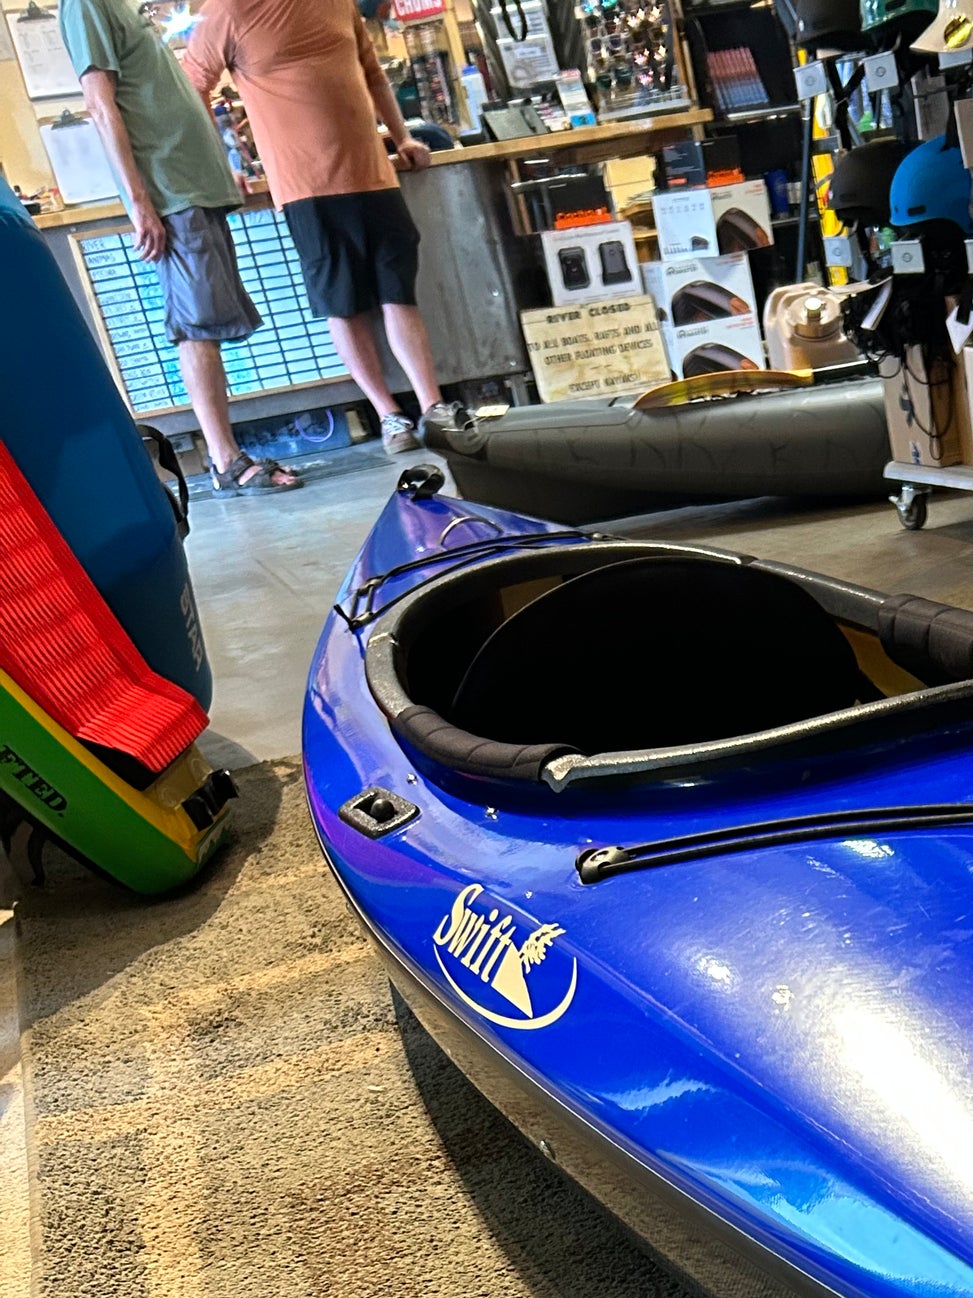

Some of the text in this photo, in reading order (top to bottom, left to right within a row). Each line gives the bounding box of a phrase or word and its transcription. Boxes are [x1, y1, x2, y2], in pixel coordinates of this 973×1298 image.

[546, 303, 631, 325] RIVER CLOSED
[623, 325, 641, 335] AND
[544, 354, 573, 365] OTHER
[619, 339, 654, 353] DEVICES
[432, 882, 517, 983] Swift
